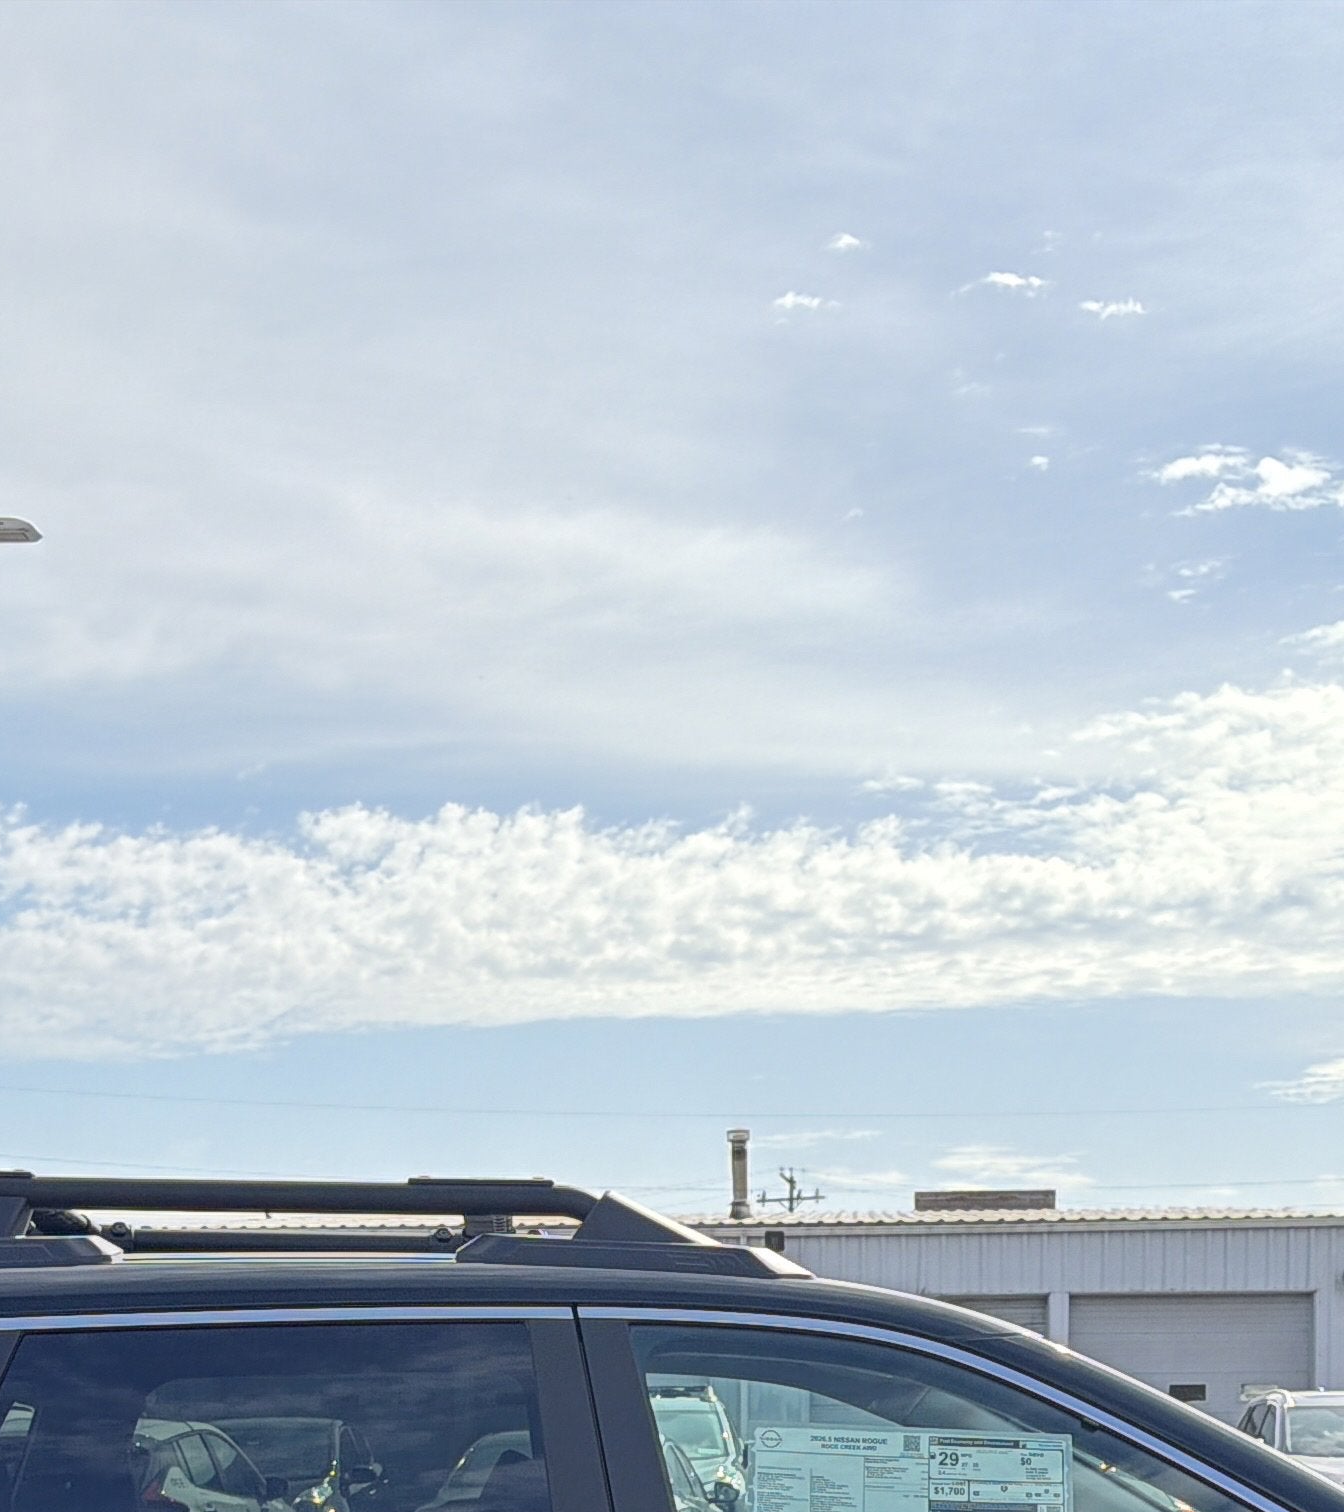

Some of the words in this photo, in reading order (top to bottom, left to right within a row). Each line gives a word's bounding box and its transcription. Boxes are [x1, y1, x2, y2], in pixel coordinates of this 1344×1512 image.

[938, 1451, 959, 1467] 29
[1020, 1457, 1032, 1466] $0
[934, 1487, 966, 1497] $1,700
